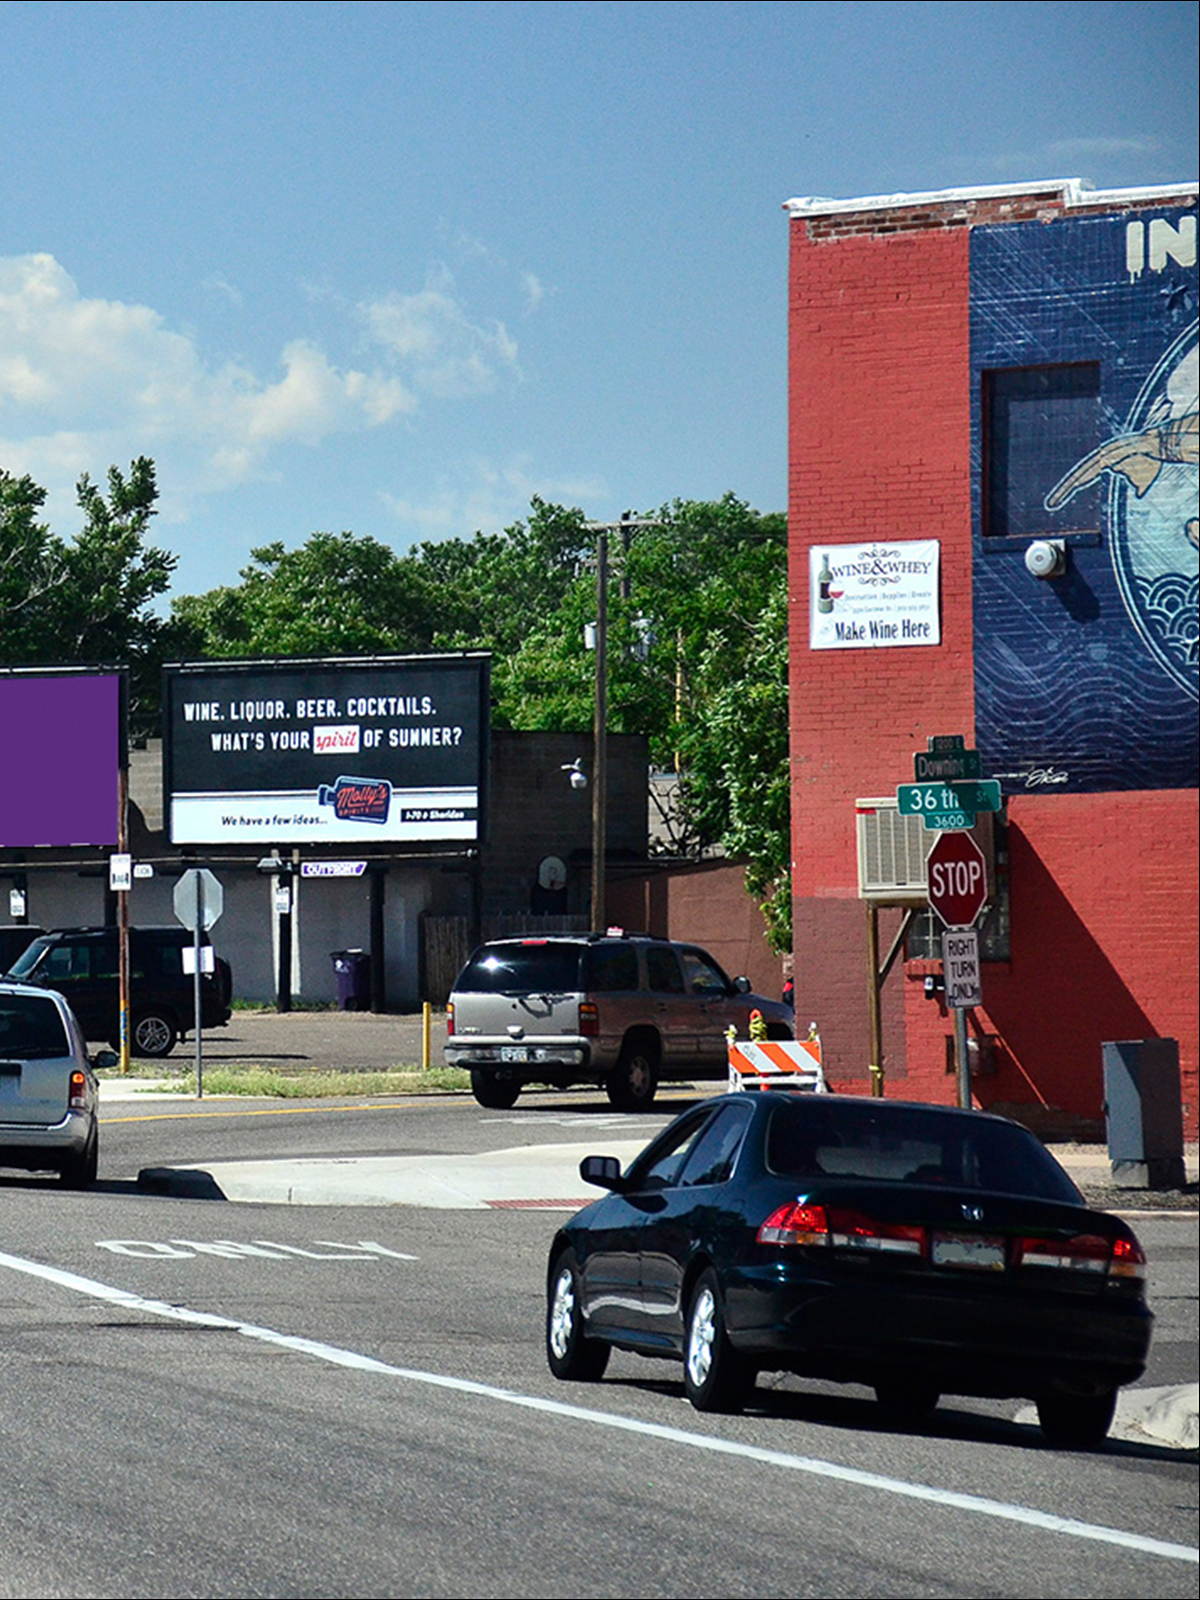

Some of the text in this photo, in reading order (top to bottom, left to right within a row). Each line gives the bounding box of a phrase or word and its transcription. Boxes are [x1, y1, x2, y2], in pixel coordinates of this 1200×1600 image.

[835, 618, 931, 641] Make Wine Here
[184, 696, 437, 723] WINE. LIQUOR. BEER. COCKTAILS.
[211, 726, 463, 751] WHAT'S YOUR spirit OF SUMMER?
[918, 755, 966, 778] Downing
[336, 784, 388, 808] Molly's
[221, 816, 238, 826] We
[239, 815, 263, 826] have
[272, 814, 292, 826] few
[429, 809, 465, 819] Sheridan
[934, 815, 965, 828] 3600
[932, 860, 981, 898] STOP
[948, 938, 975, 956] RIGHT
[950, 960, 976, 978] TURN
[951, 982, 977, 1000] ONLY
